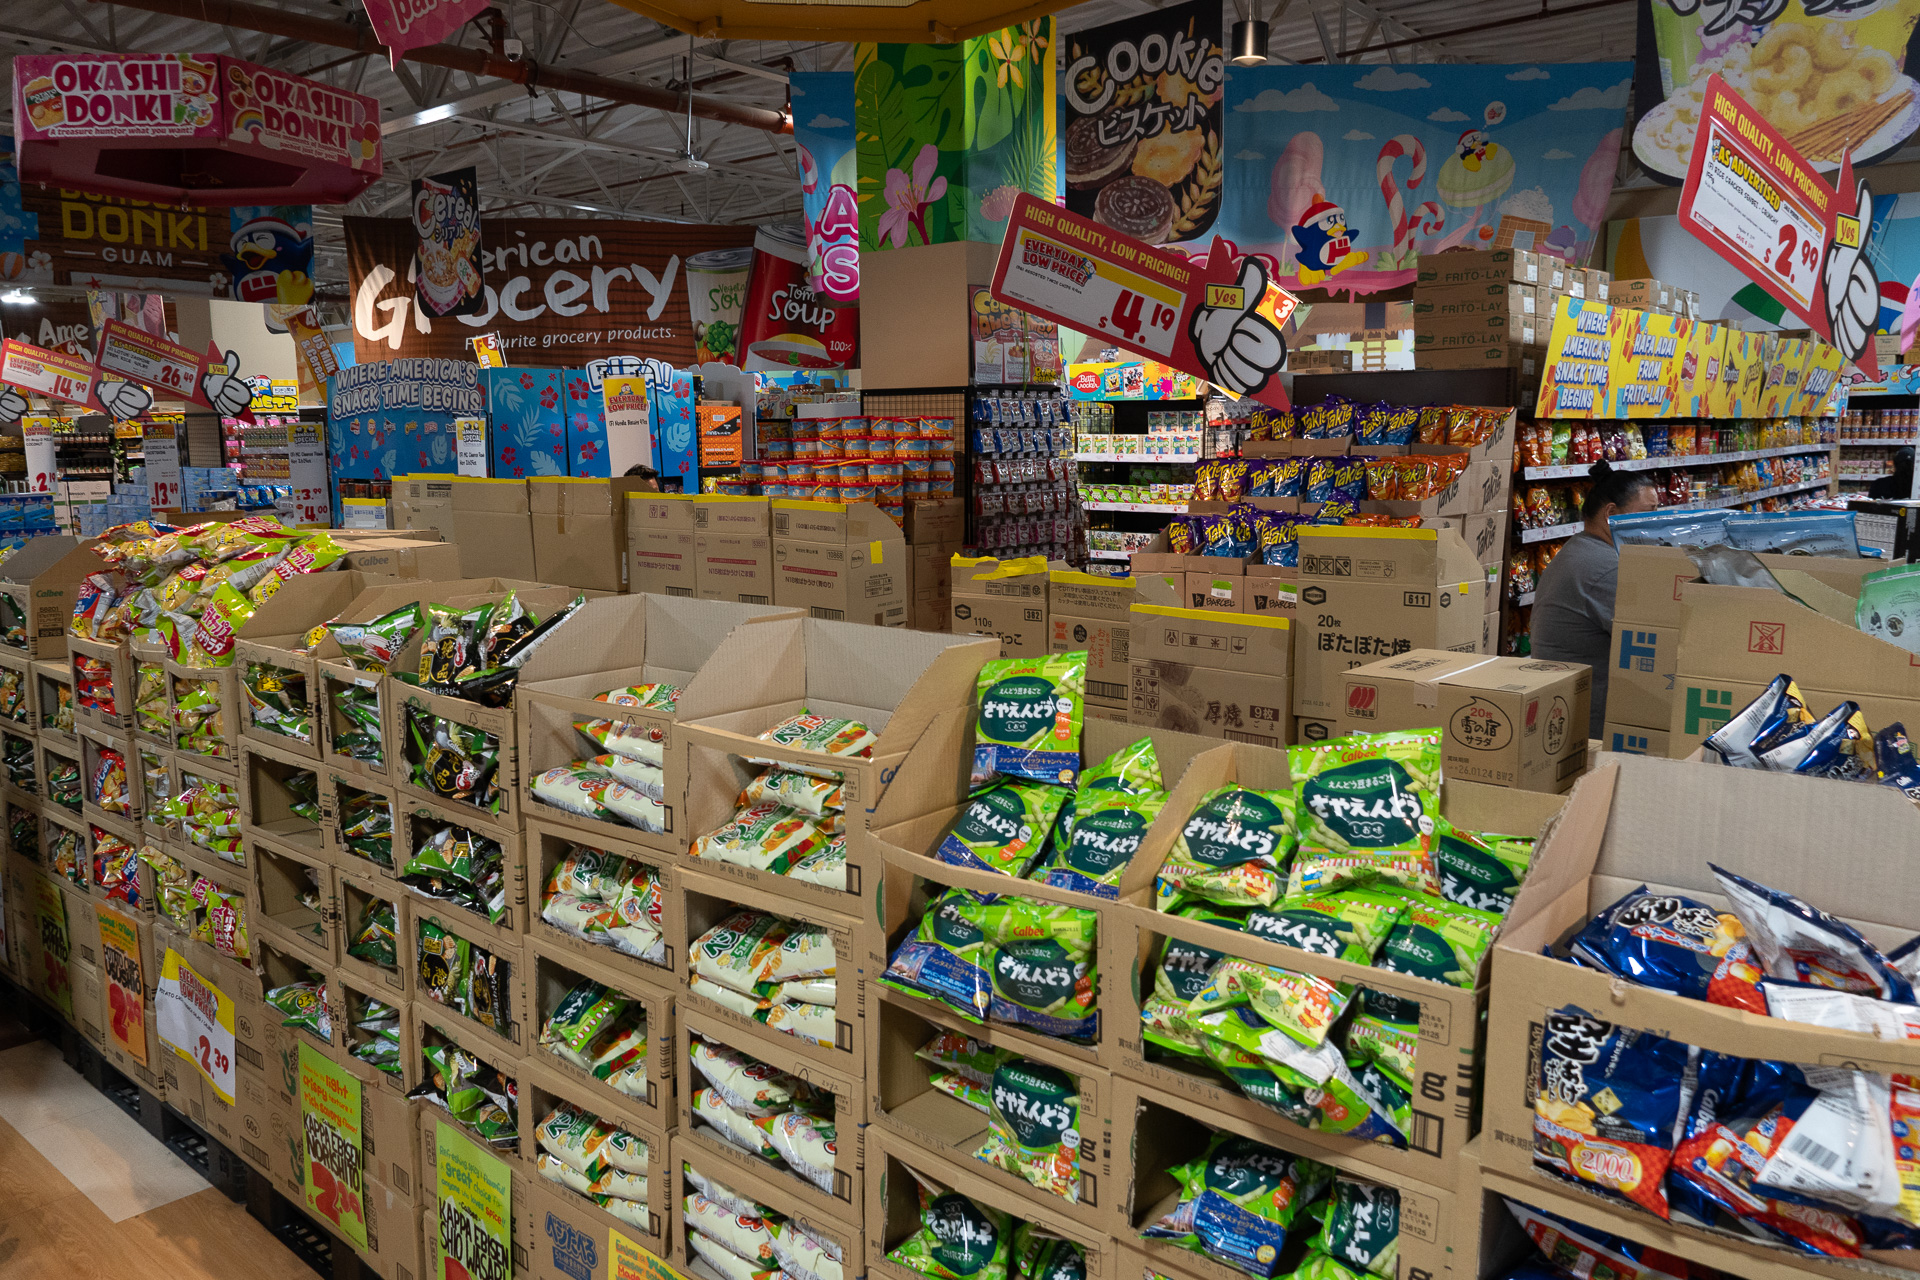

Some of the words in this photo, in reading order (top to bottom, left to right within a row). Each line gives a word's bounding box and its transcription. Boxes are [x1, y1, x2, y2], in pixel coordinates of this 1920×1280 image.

[54, 62, 181, 92] OKASHI
[1065, 31, 1223, 115] Cookie
[65, 93, 172, 123] DONKI
[254, 73, 353, 124] OKASHI
[263, 104, 347, 149] DONKI
[1098, 95, 1206, 145] ビスケット
[58, 128, 93, 136] treasure
[126, 127, 150, 135] what
[152, 128, 168, 137] you
[1714, 92, 1737, 125] HIGH
[1738, 114, 1774, 164] QUALITY,
[1775, 149, 1795, 178] LOW
[1794, 166, 1828, 213] PRICING!!
[1715, 166, 1725, 180] RICE
[1718, 146, 1731, 168] AS
[1730, 154, 1780, 211] ADVERTISED
[414, 190, 478, 239] Cereal
[62, 201, 208, 251] DONKI
[434, 225, 466, 243] シリアル
[1840, 219, 1855, 243] Yes
[1024, 238, 1084, 269] EVERYDAY
[1025, 204, 1054, 228] HIGH
[1057, 218, 1108, 253] QUALITY,
[1110, 240, 1137, 262] LOW
[1137, 252, 1190, 285] PRICING!!
[102, 247, 173, 267] GUAM
[1496, 254, 1507, 262] UP
[1022, 251, 1050, 269] LOW
[1051, 261, 1089, 287] PRICE!
[1445, 268, 1508, 282] FRITO-LAY
[1212, 287, 1236, 307] Yes
[1441, 301, 1503, 315] FRITO-LAY
[305, 310, 317, 327] 4
[768, 290, 836, 333] Soup
[1275, 299, 1294, 318] 3
[1577, 310, 1608, 335] WHERE
[67, 341, 76, 354] 6
[110, 323, 127, 335] HIGH
[127, 329, 156, 347] QUALITY,
[156, 341, 171, 352] LOW
[171, 346, 200, 363] PRICING!!
[487, 335, 496, 349] 5
[542, 330, 602, 348] grocery
[607, 326, 676, 347] products.
[829, 340, 852, 352] 100%
[1442, 334, 1503, 346] FRITO-LAY
[1562, 335, 1611, 361] AMERICA'S
[1655, 336, 1678, 358] ADAI
[8, 342, 23, 352] HIGH
[50, 355, 64, 364] LOW
[312, 333, 326, 350] US
[320, 349, 336, 374] Milk
[211, 364, 225, 374] Yes
[306, 348, 327, 384] Cereal
[336, 360, 387, 393] WHERE
[389, 358, 477, 389] AMERICA'S
[1555, 360, 1587, 385] SNACK
[1587, 364, 1609, 386] TIME
[1637, 360, 1662, 381] FROM
[1076, 380, 1099, 390] Crocker
[1079, 373, 1096, 385] Betty
[1803, 367, 1837, 396] BIBA!
[333, 384, 380, 420] SNACK
[382, 382, 420, 409] TIME
[422, 384, 481, 417] BEGINS
[608, 394, 645, 404] EVERYDAY
[1560, 388, 1594, 411] BEGINS
[1622, 384, 1667, 405] FRITO-LAY
[608, 403, 625, 413] LOW
[626, 402, 648, 412] PRICE!
[1326, 404, 1353, 431] Takis
[1387, 407, 1419, 432] Takis
[1219, 460, 1248, 486] Takis
[1334, 462, 1365, 488] Takis
[1437, 478, 1460, 515] Takis
[1482, 472, 1502, 512] Takis
[1476, 524, 1496, 561] Takis
[358, 554, 389, 568] Calbee
[36, 589, 64, 598] Calbee
[1205, 597, 1235, 608] BARCEL
[1408, 594, 1426, 605] 611
[215, 598, 232, 619] Calbee
[973, 617, 992, 628] 110g
[1317, 614, 1342, 628] 20枚
[1317, 632, 1411, 657] ぽたぽた焼
[1203, 700, 1244, 728] 厚焼
[1254, 707, 1274, 721] 9枚
[1347, 708, 1375, 718] 三幸製菓
[1469, 707, 1493, 718] 20枚
[1253, 719, 1275, 732] ごま
[1461, 716, 1501, 736] 雪の宿
[1465, 735, 1493, 747] サラダ
[1341, 750, 1377, 763] Calbee
[1328, 773, 1392, 789] えんどう豆まるごと
[1352, 825, 1384, 836] しお味
[1410, 911, 1439, 928] Calbee
[1013, 926, 1044, 937] Calbee
[179, 981, 194, 1003] LOW
[303, 1074, 328, 1101] crispy
[325, 1074, 348, 1099] light
[1008, 1070, 1057, 1093] えんどう豆まるごと
[304, 1091, 320, 1110] rich
[319, 1102, 342, 1127] savory
[1693, 1088, 1719, 1134] Calbee
[303, 1110, 331, 1148] KAPPA
[331, 1131, 361, 1170] EBISEN
[445, 1162, 473, 1189] great
[473, 1182, 492, 1203] choice
[470, 1194, 485, 1211] loves
[438, 1196, 473, 1243] KAPPA
[474, 1224, 510, 1271] EBISEN
[440, 1220, 463, 1262] SHIO
[544, 1211, 599, 1270] ベジたべる
[616, 1238, 639, 1260] Enjoy
